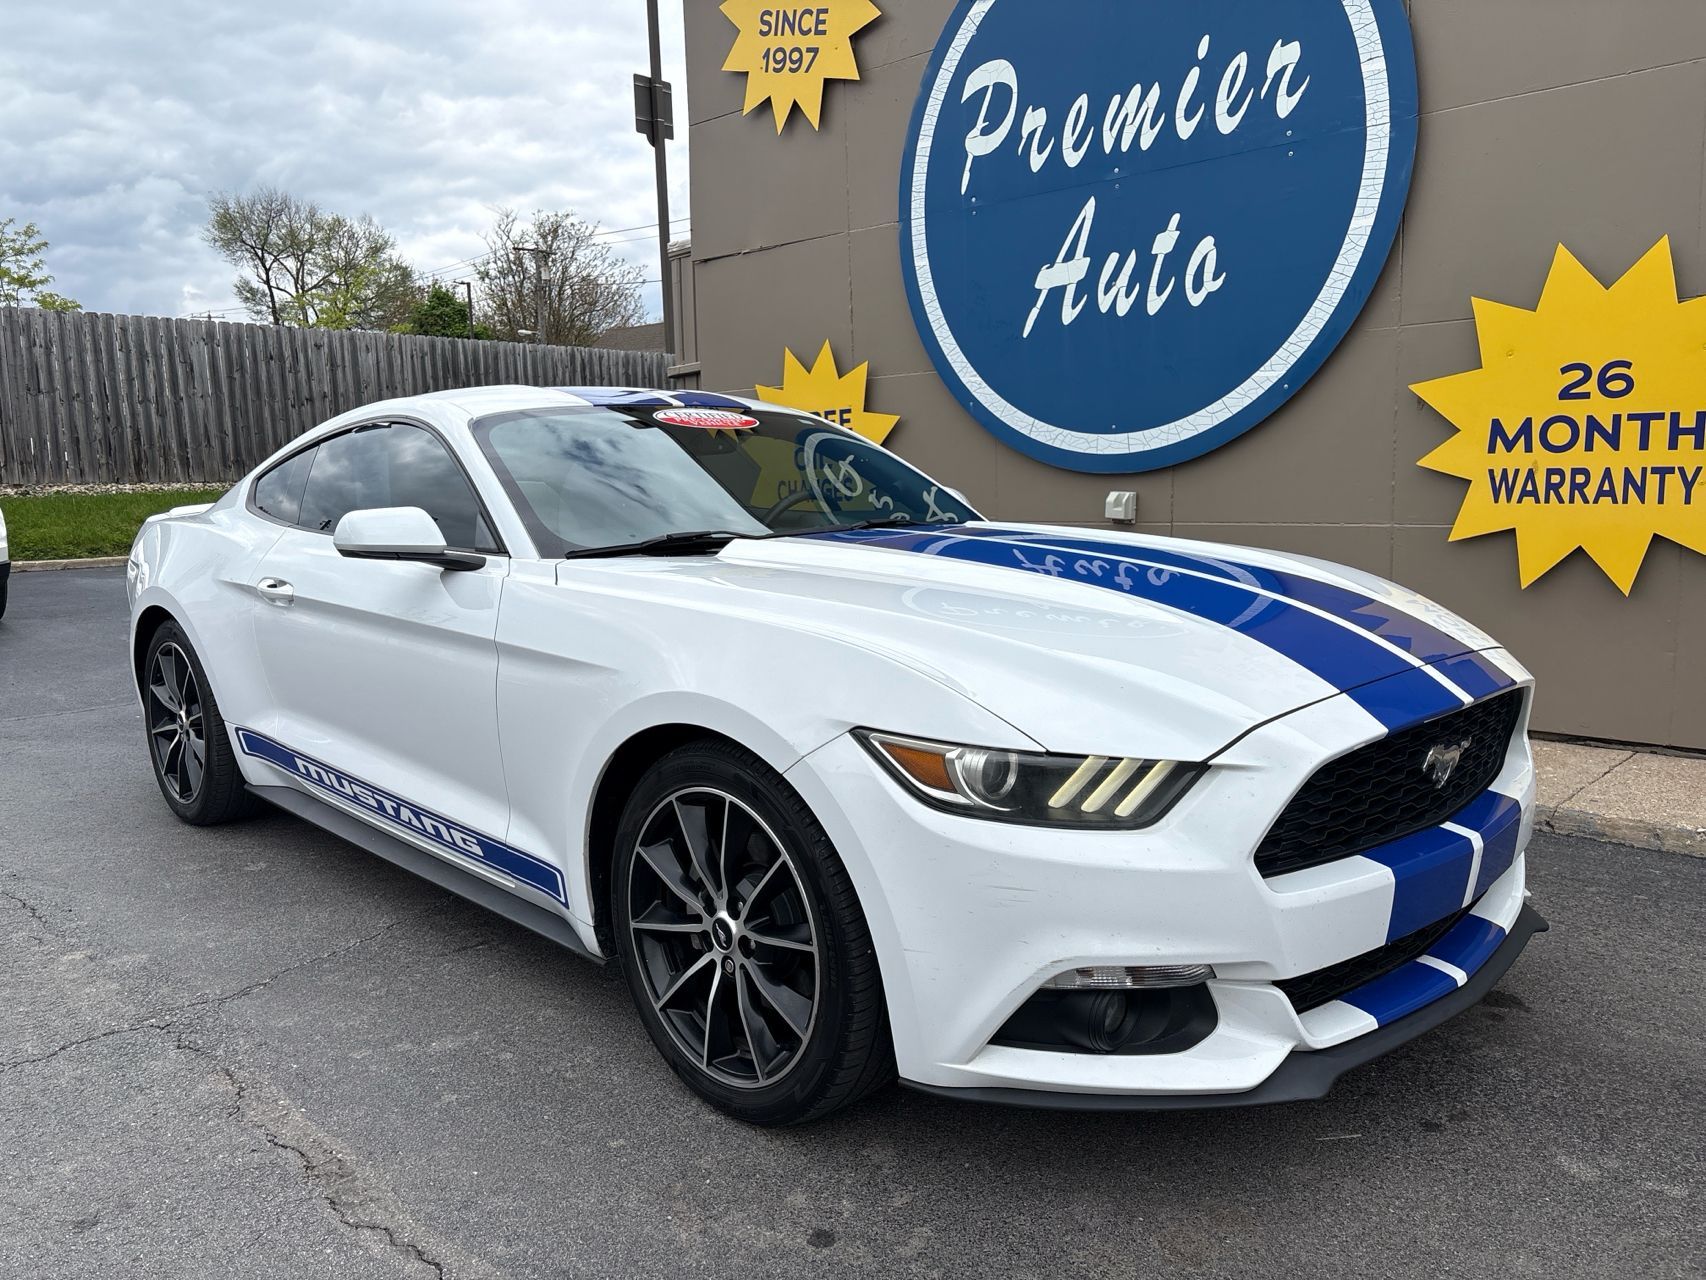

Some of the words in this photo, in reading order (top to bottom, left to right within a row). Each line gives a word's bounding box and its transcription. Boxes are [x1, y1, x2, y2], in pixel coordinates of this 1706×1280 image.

[758, 8, 829, 37] SINCE
[762, 47, 819, 74] 1997
[960, 34, 1310, 195] Premier
[1022, 196, 1226, 338] Auto
[1558, 360, 1635, 401] 26
[1487, 411, 1706, 454] MONTH
[1487, 466, 1704, 505] WARRANTY
[293, 756, 484, 857] MUSTANG
